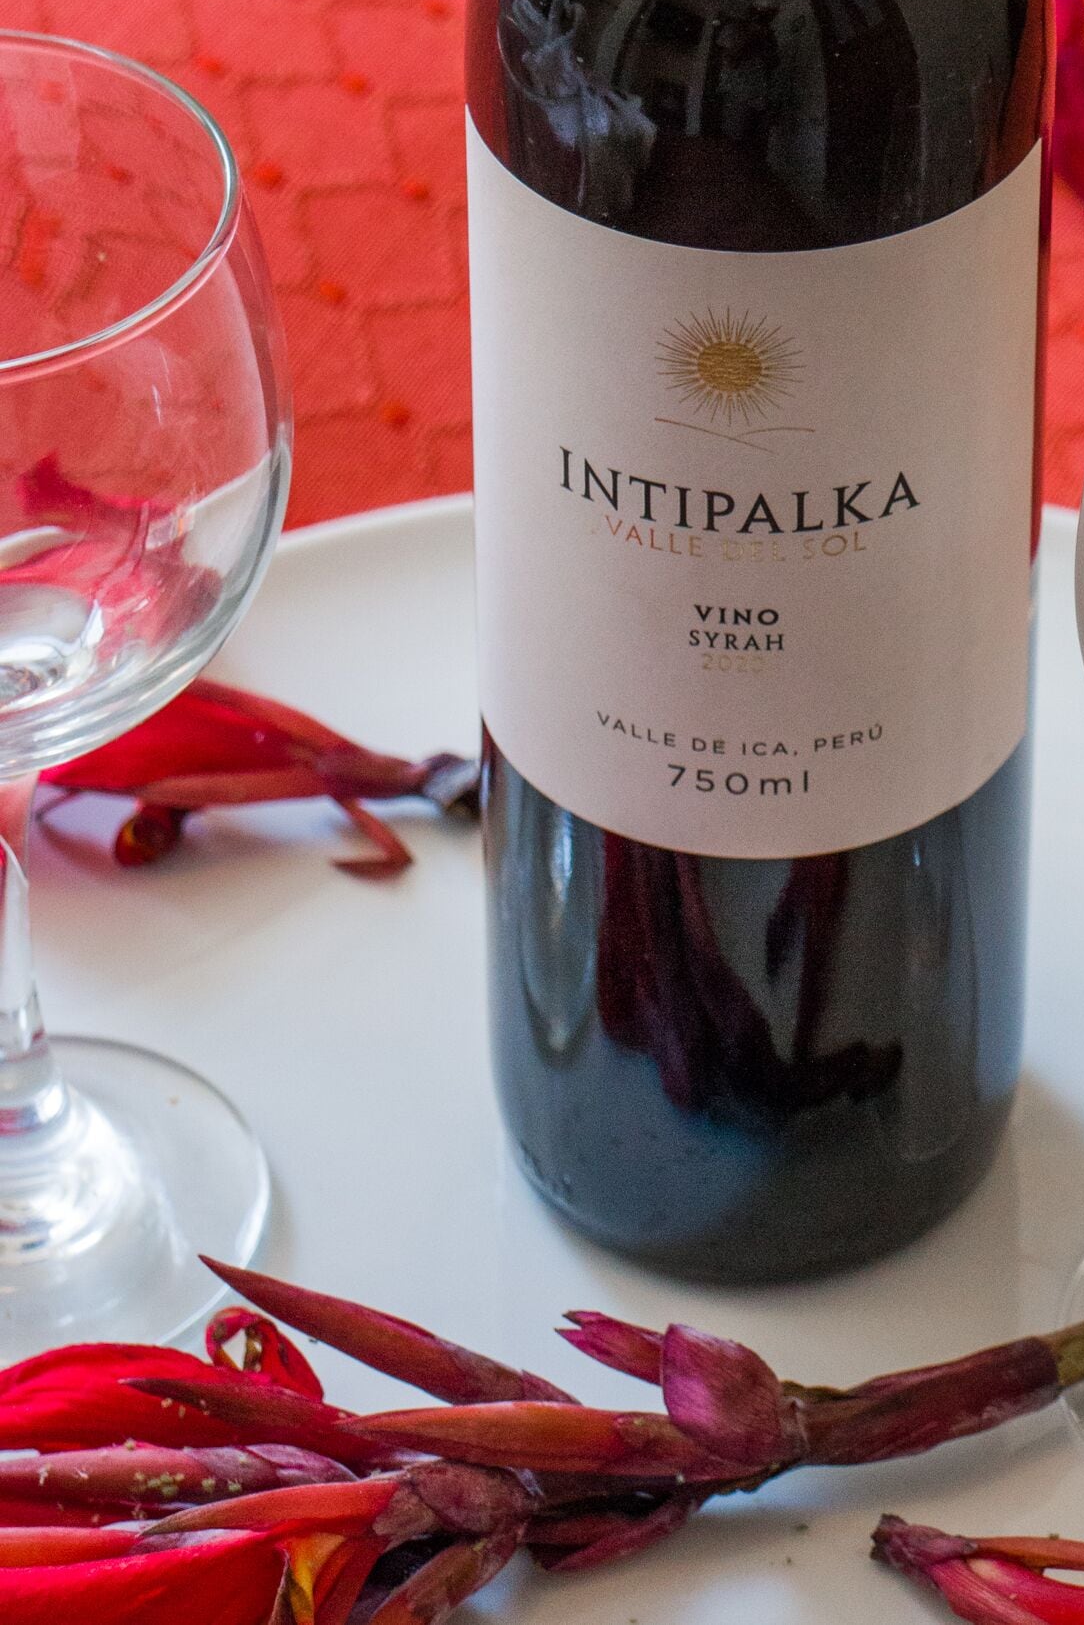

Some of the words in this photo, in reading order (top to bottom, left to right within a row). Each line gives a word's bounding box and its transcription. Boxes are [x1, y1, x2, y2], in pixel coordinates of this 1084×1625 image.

[559, 446, 921, 535] INTIPALKA
[604, 514, 704, 558] VALLE
[722, 537, 786, 563] DEL
[803, 531, 867, 560] SOL
[694, 604, 780, 626] VINO
[689, 629, 785, 651] SYRAH
[597, 710, 677, 747] VALLE
[692, 737, 726, 755] DE
[742, 742, 799, 757] ICA,
[813, 723, 884, 753] PERÚ
[667, 763, 810, 796] 750ml
